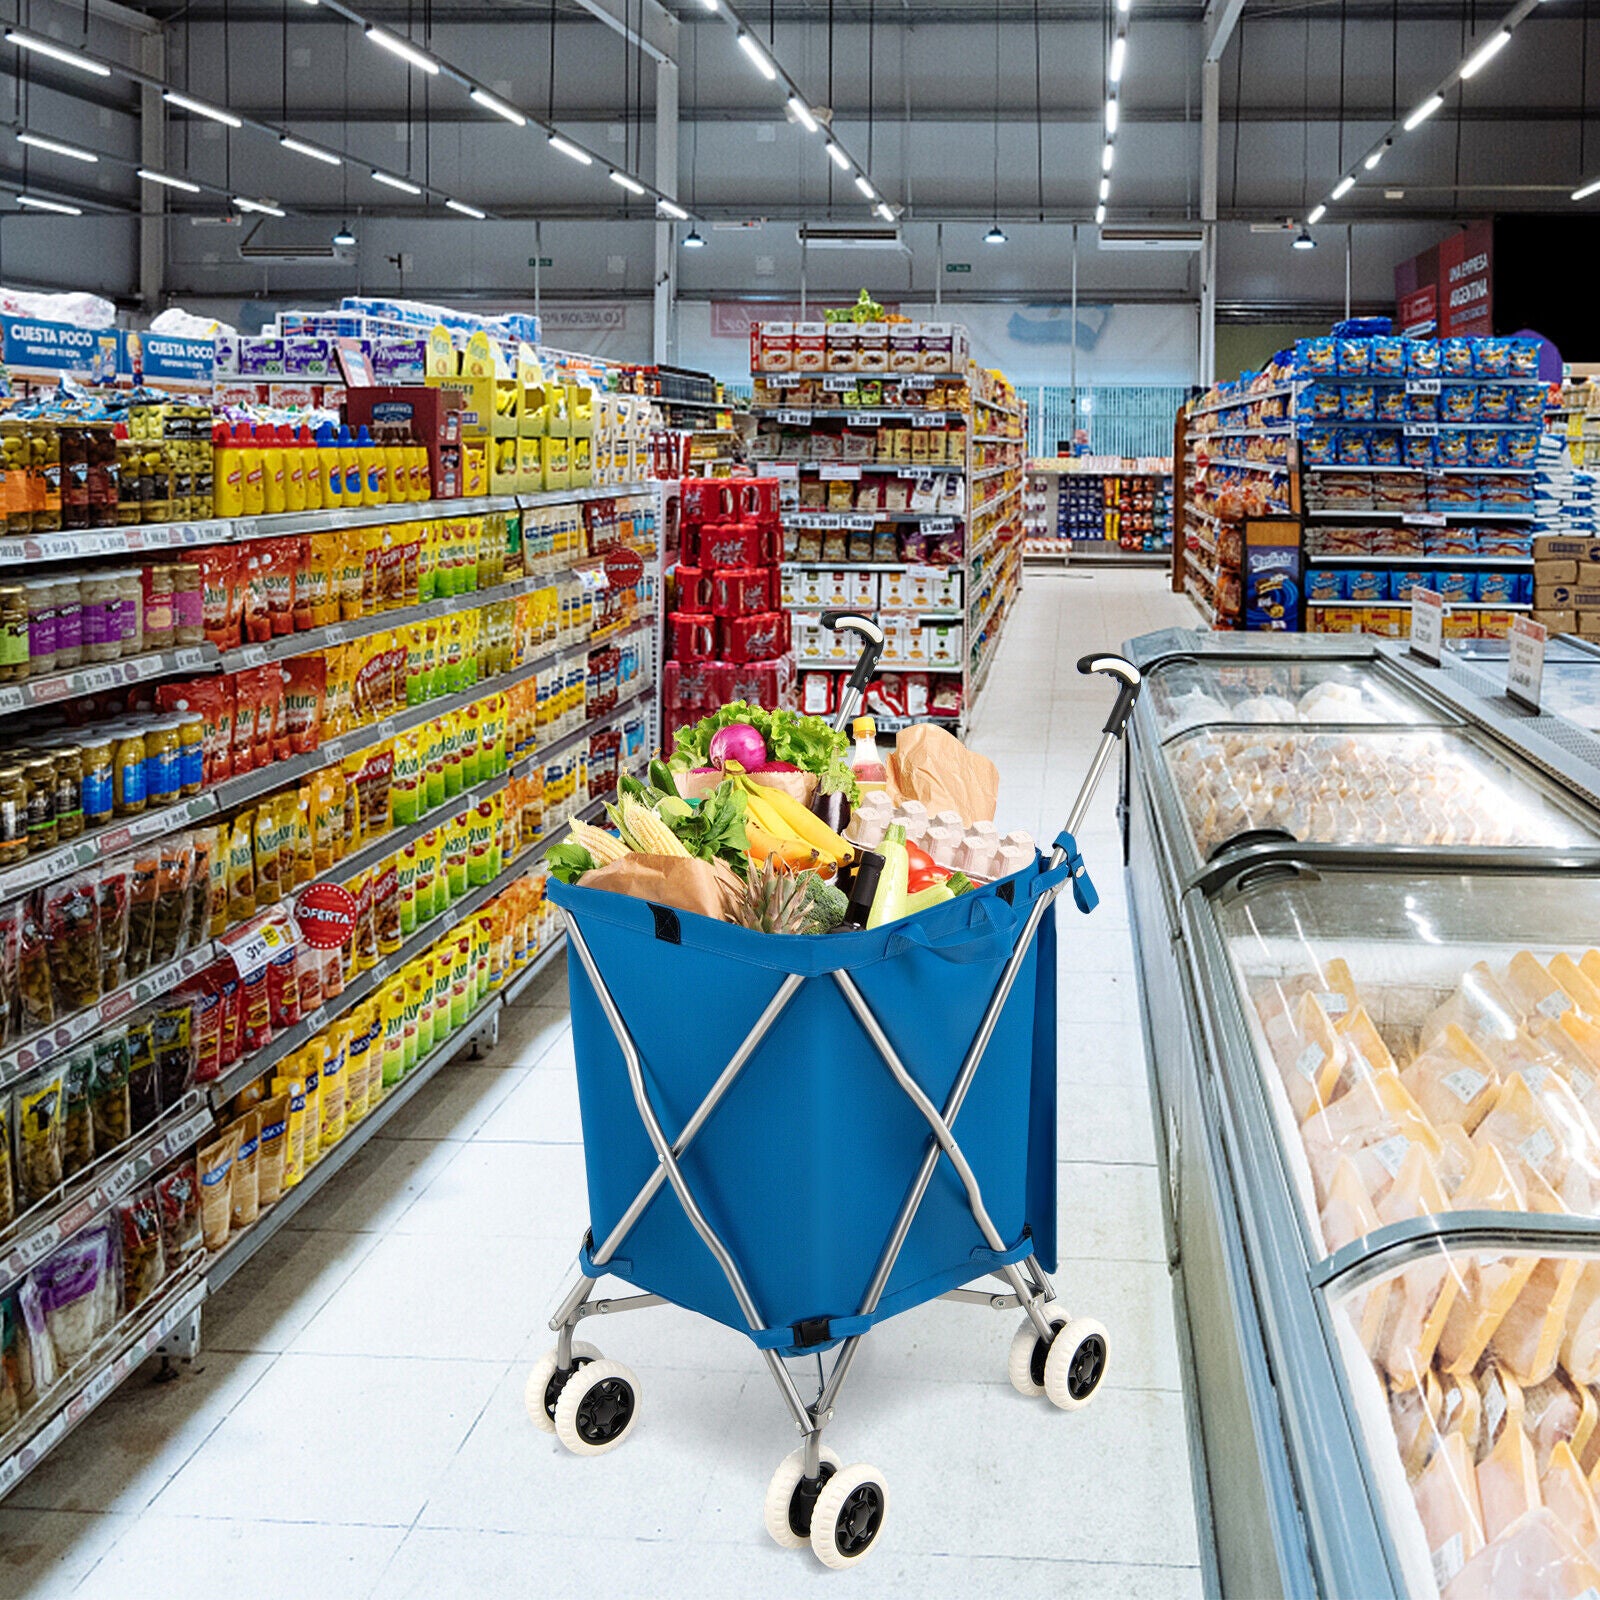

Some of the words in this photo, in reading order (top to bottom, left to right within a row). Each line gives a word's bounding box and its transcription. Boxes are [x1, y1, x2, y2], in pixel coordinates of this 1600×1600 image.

[11, 324, 57, 344] CUESTA
[59, 331, 93, 347] POCO
[148, 341, 185, 357] CUESTA
[187, 345, 213, 360] POCO
[300, 906, 350, 925] OFERTA
